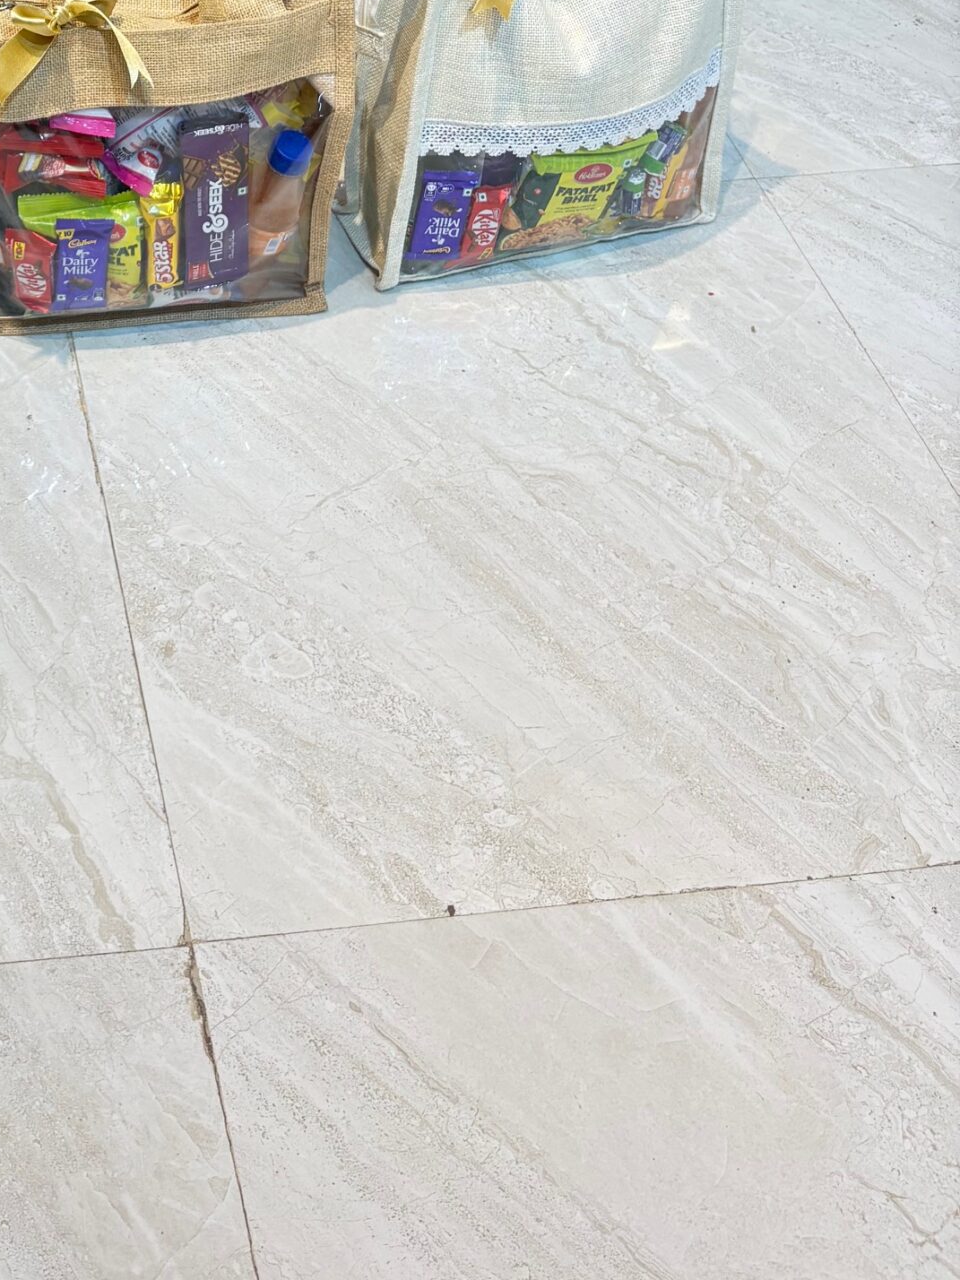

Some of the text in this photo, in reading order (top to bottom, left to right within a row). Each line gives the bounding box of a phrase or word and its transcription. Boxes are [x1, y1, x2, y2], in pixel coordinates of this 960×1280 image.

[555, 181, 616, 196] FATAFAT
[561, 194, 598, 205] BHEL
[431, 218, 460, 228] Milk
[424, 225, 460, 237] Dairy
[62, 256, 99, 267] Dairy
[63, 265, 93, 275] Milk
